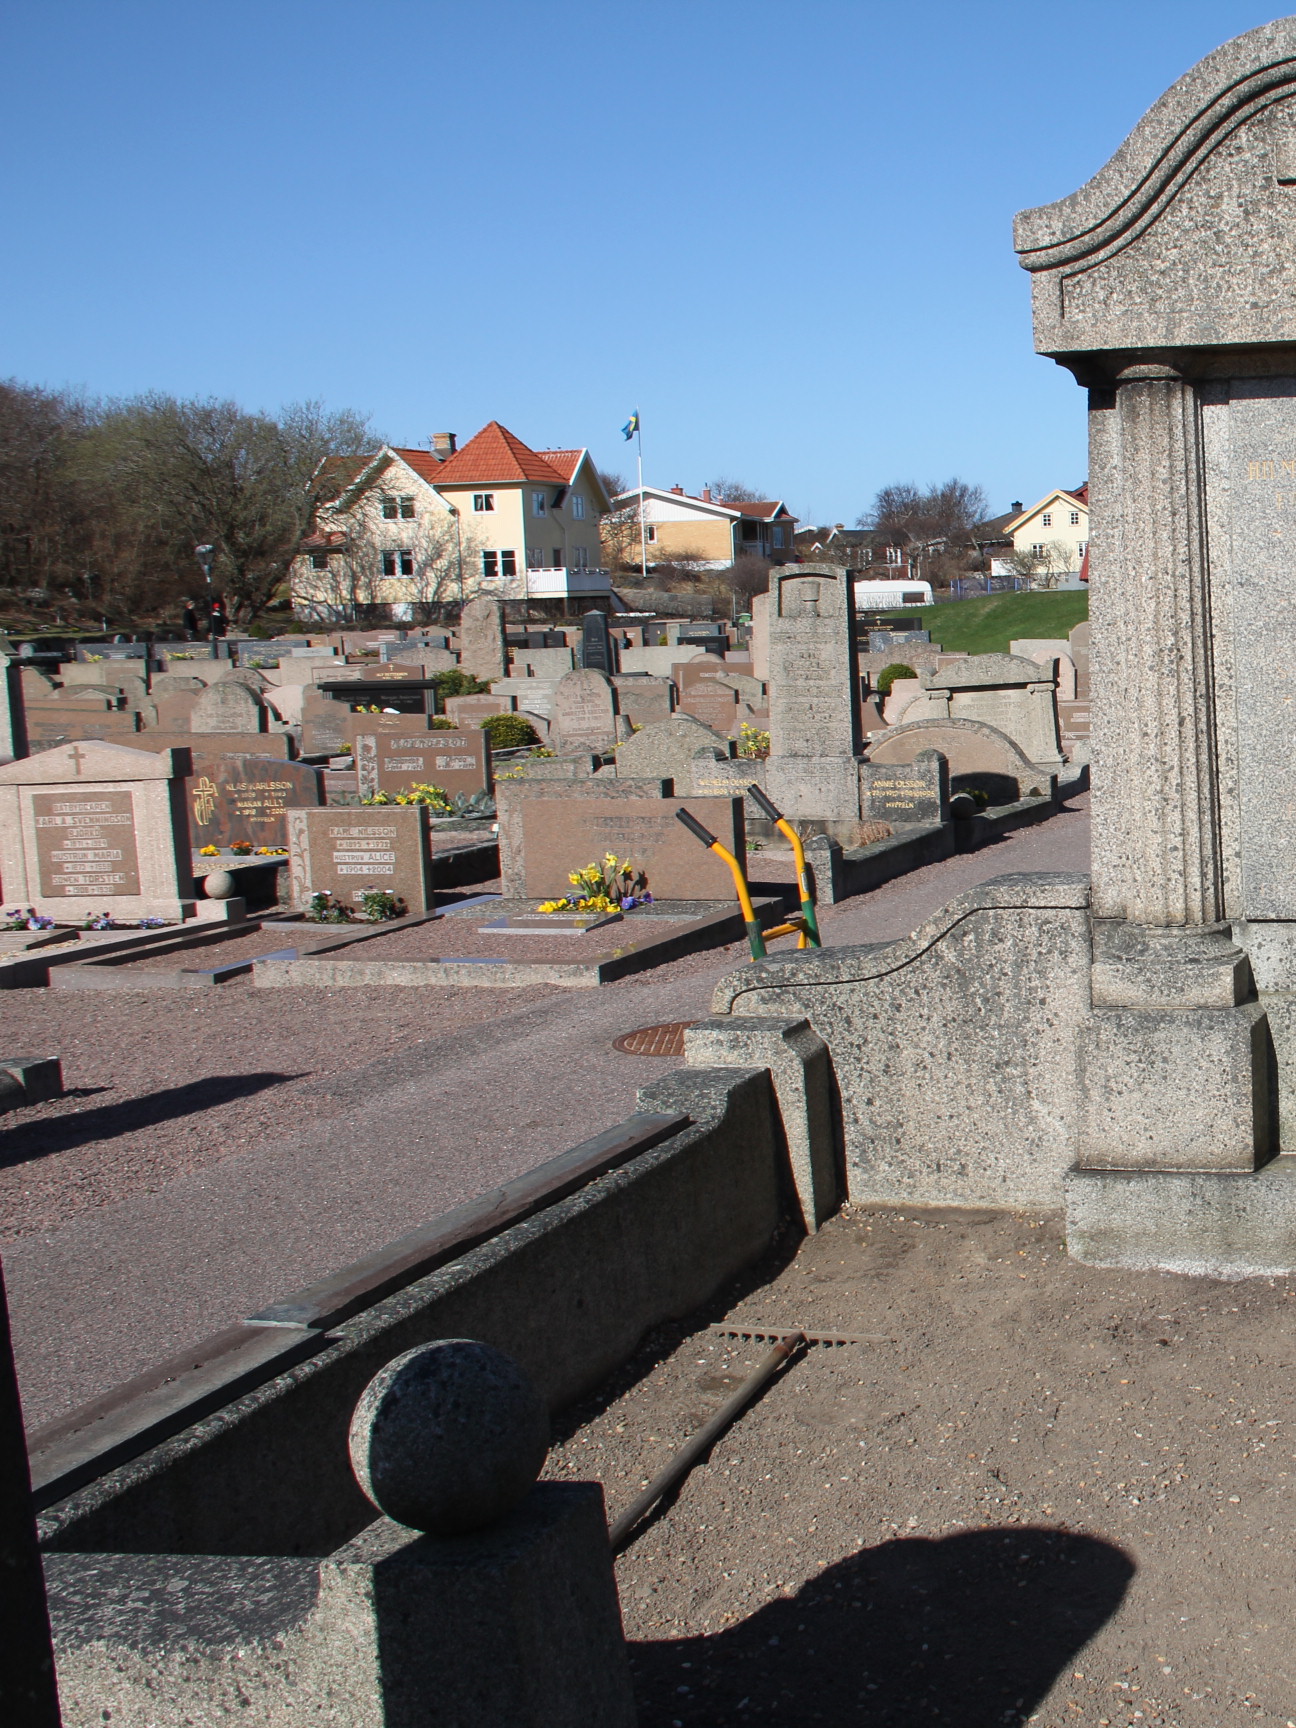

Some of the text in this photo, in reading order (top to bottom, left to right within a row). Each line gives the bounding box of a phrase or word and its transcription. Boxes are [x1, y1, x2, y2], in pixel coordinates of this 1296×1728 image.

[226, 781, 293, 791] KLAS KARLSSON
[872, 780, 926, 788] ANNIE OLSSON
[263, 799, 284, 807] ALLY
[36, 816, 59, 827] KARL
[330, 827, 396, 837] KARL NILSSON
[52, 850, 121, 861] HUSTRUN MARIA
[368, 853, 395, 861] ALICE
[371, 865, 393, 873] 2004
[82, 874, 126, 883] TORSTEN
